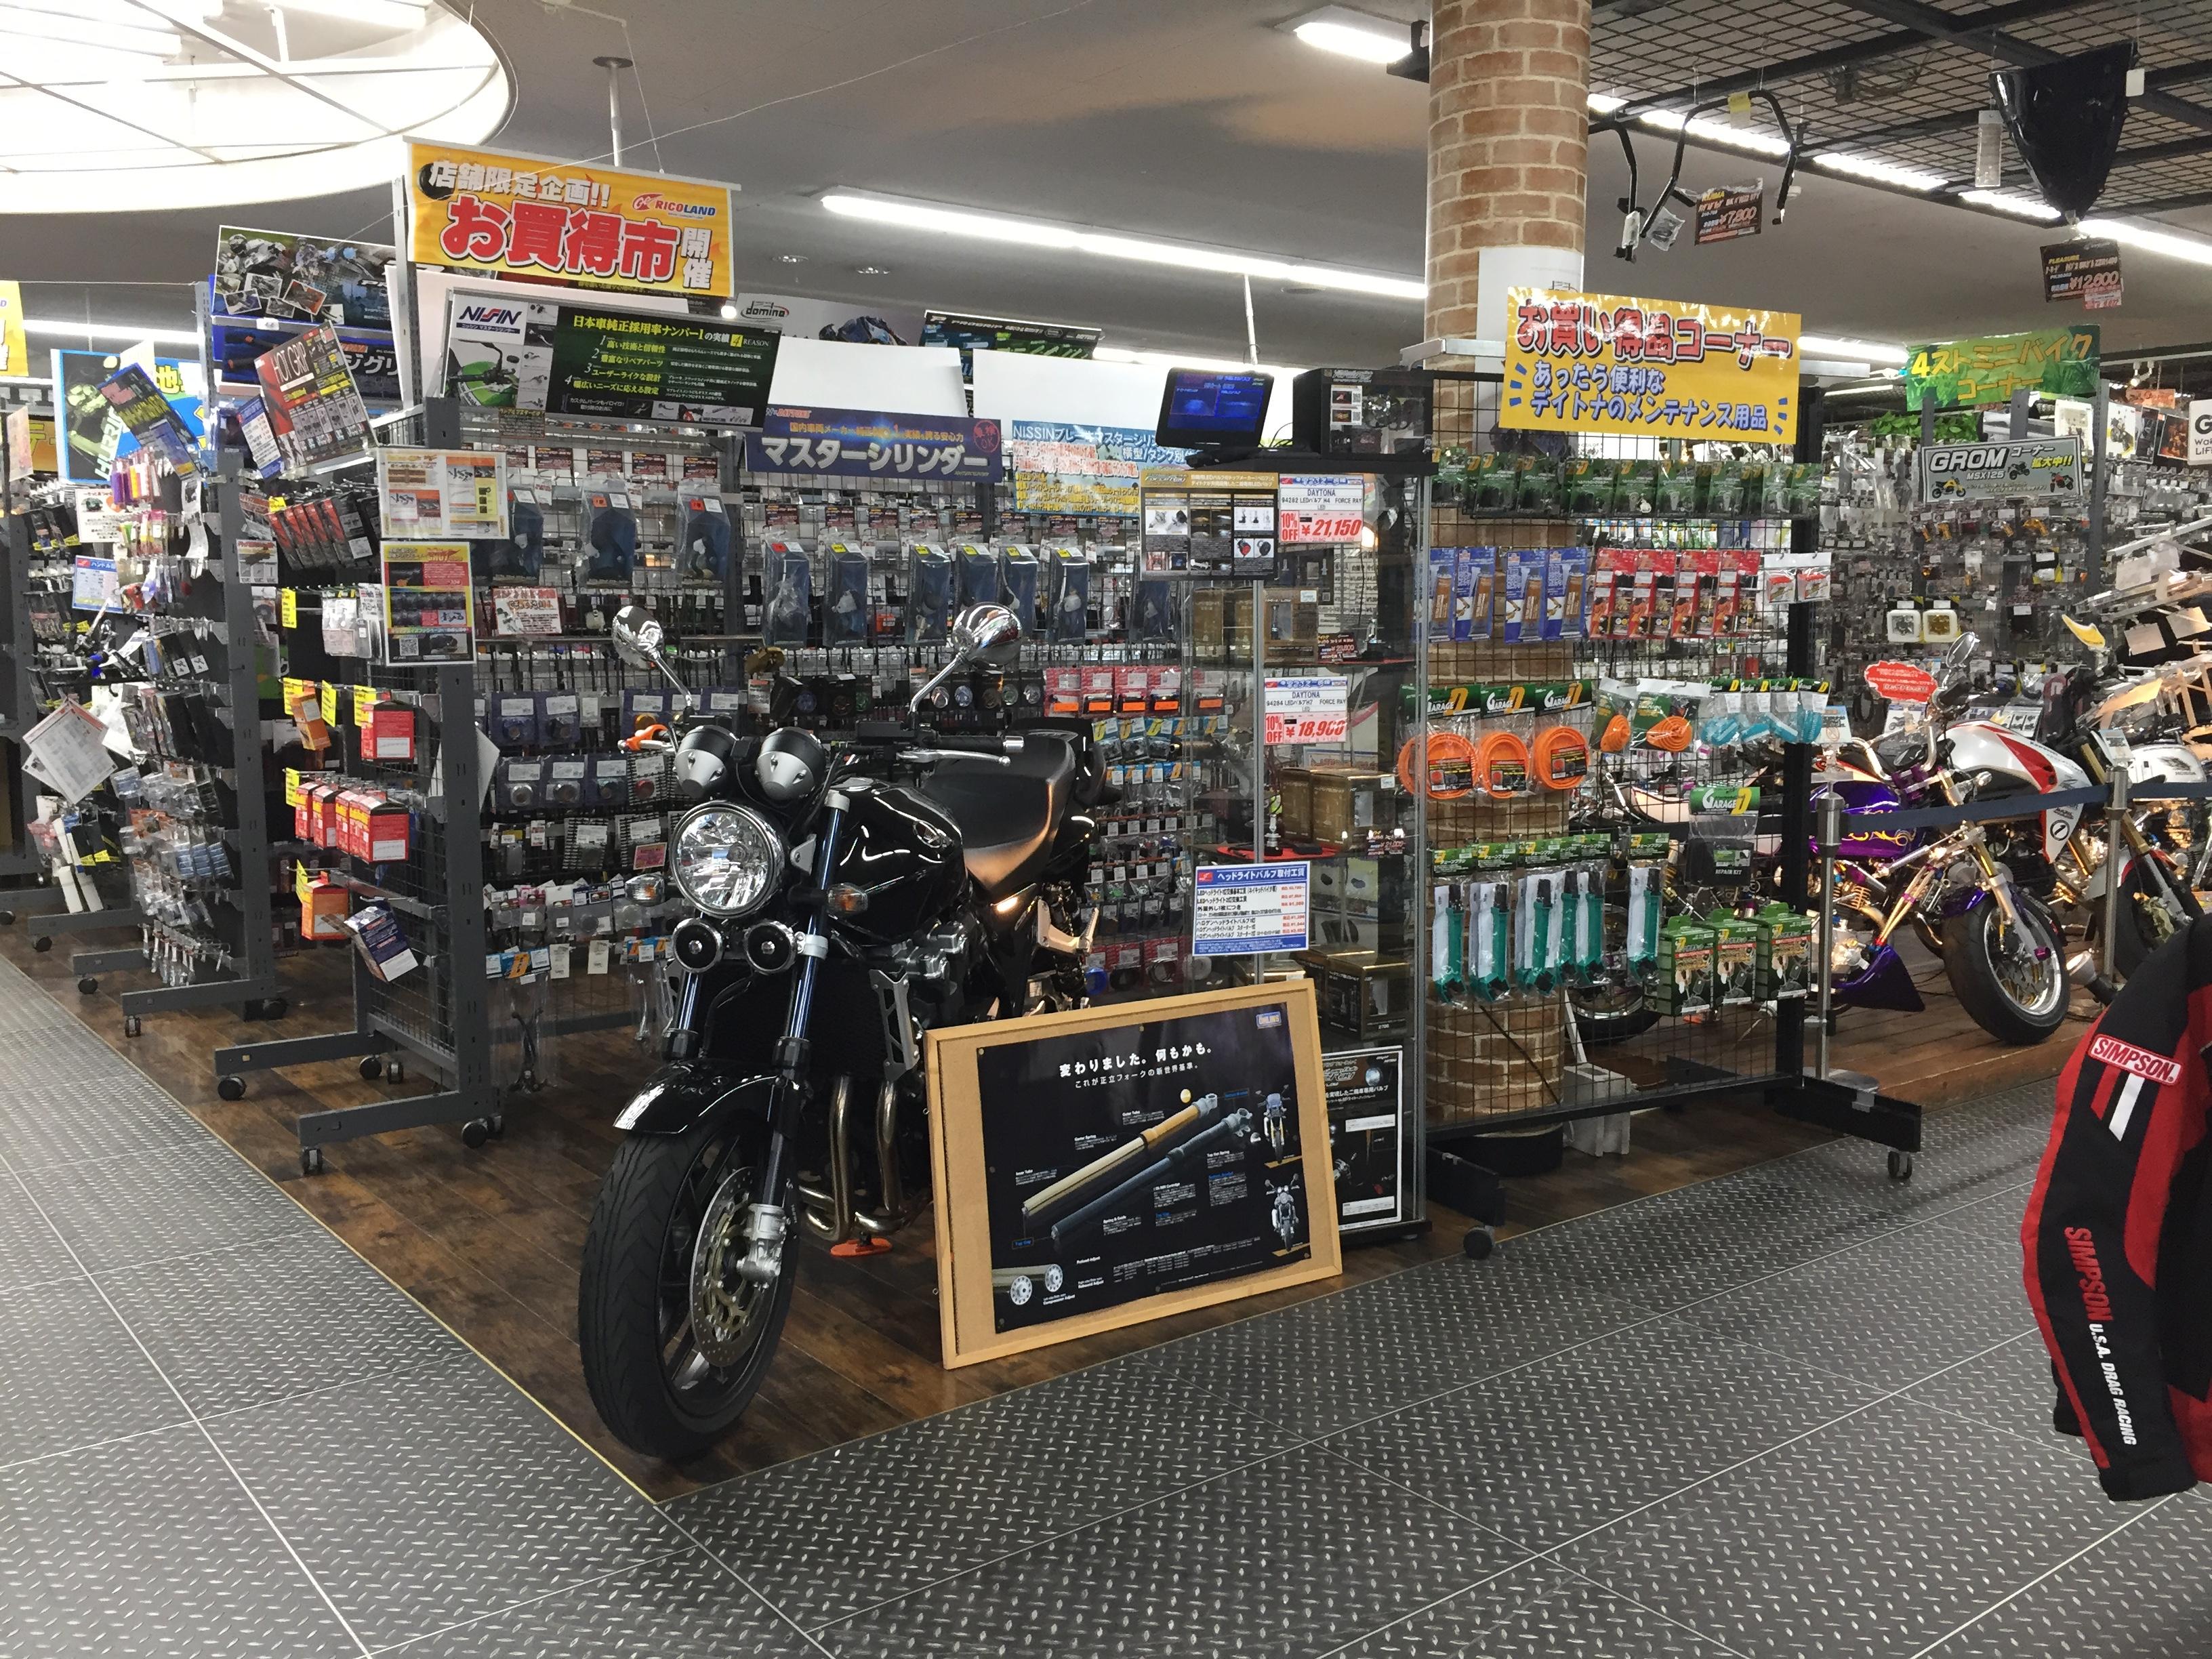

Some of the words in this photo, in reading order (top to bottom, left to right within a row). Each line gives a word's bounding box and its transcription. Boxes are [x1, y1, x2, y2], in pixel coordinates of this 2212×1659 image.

[428, 160, 611, 208] 店舗限定企画!!
[655, 200, 716, 216] RICOLAND
[440, 193, 681, 282] お買得市
[680, 227, 713, 289] 開催
[745, 301, 786, 317] domino
[743, 338, 770, 347] REASON
[1518, 299, 1793, 369] お買い得品コーナー
[287, 340, 310, 377] GRIP
[1912, 333, 2094, 378] 4ストミニバイク
[1534, 360, 1665, 394] あったら便利な
[1957, 371, 2044, 401] コーナー
[1530, 393, 1768, 431] デイトナのメンテナンス用品
[761, 437, 988, 475] マスターシリンダー
[1929, 447, 2010, 473] GROM
[2010, 445, 2055, 458] コーナー
[2030, 455, 2074, 469] 拡大中!!
[1966, 470, 2005, 480] MSX125
[1307, 489, 1336, 497] DAYTONA
[1281, 512, 1298, 528] 10%
[1282, 529, 1298, 541] OFF
[1486, 692, 1513, 710] GARAGE
[1544, 690, 1572, 709] GARAGE
[1266, 715, 1282, 731] 10%
[1267, 731, 1282, 743] OFF
[1702, 787, 1737, 811] GARAGE
[1217, 867, 1305, 882] ヘッドライトバルブ取付工賃
[1059, 1052, 1147, 1078] 変わりました。
[1155, 1042, 1212, 1063] 何もかも。
[2093, 1038, 2175, 1082] SIMPSON
[1075, 1061, 1198, 1089] これが正立フォークの新世界基準。
[2064, 1226, 2114, 1322] SIMPSON
[2089, 1322, 2112, 1359] U.S.A.
[2101, 1361, 2125, 1396] DRAG
[2113, 1397, 2137, 1446] RACING
